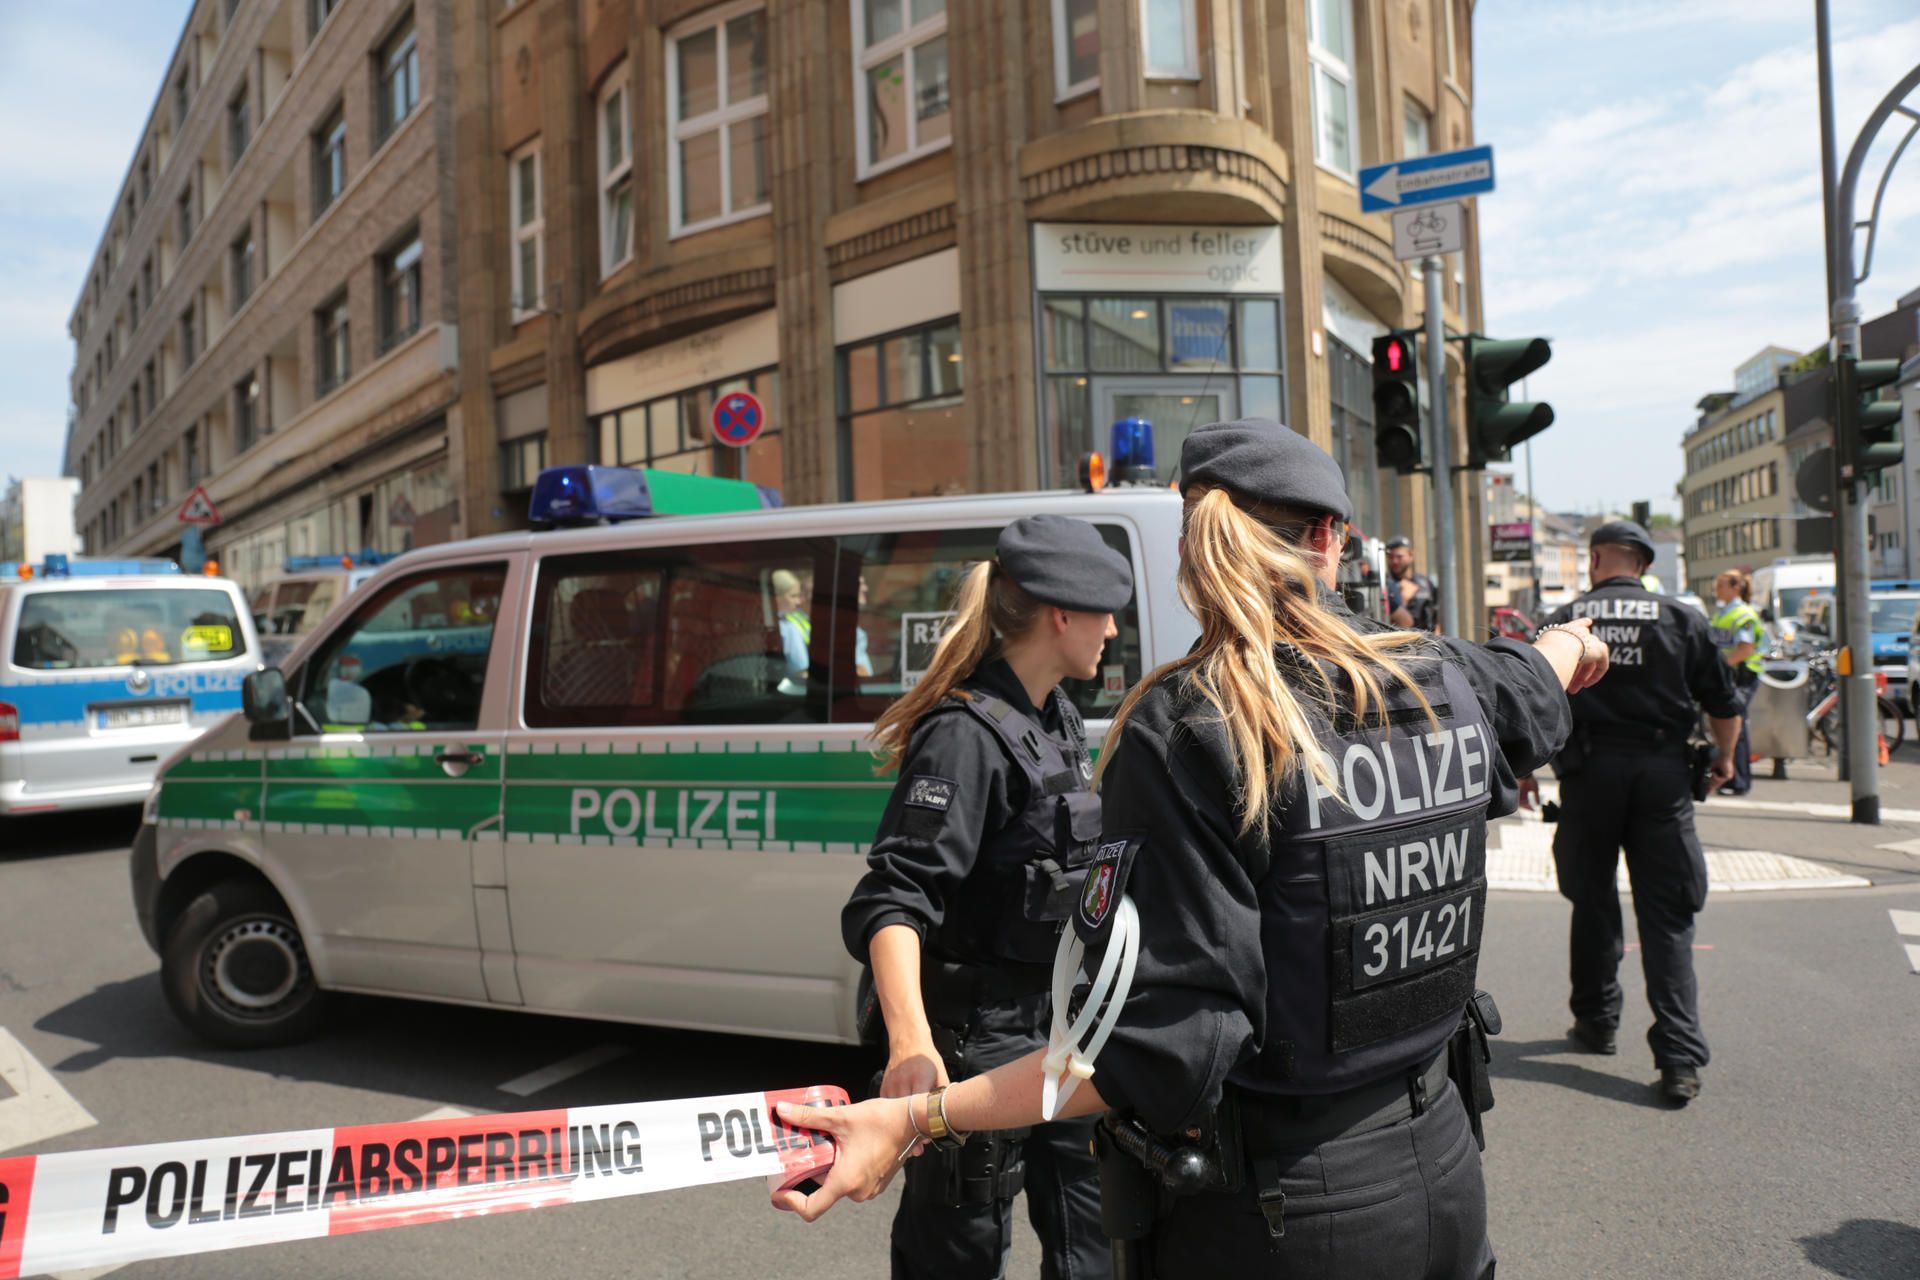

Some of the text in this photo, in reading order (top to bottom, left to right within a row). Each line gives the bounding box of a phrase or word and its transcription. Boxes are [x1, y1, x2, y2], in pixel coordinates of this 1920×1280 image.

[1061, 232, 1257, 256] stüve und feller
[1207, 265, 1260, 284] optic
[1571, 599, 1660, 620] POLIZEI
[1592, 626, 1640, 643] NRW
[1610, 646, 1643, 665] 421
[154, 671, 244, 696] POLIZE
[1299, 723, 1490, 830] POLIZEI
[570, 788, 776, 840] POLIZEI
[1364, 828, 1469, 905] NRW
[1363, 896, 1472, 977] 31421
[101, 1120, 644, 1235] POLIZEIABSPERRUNG
